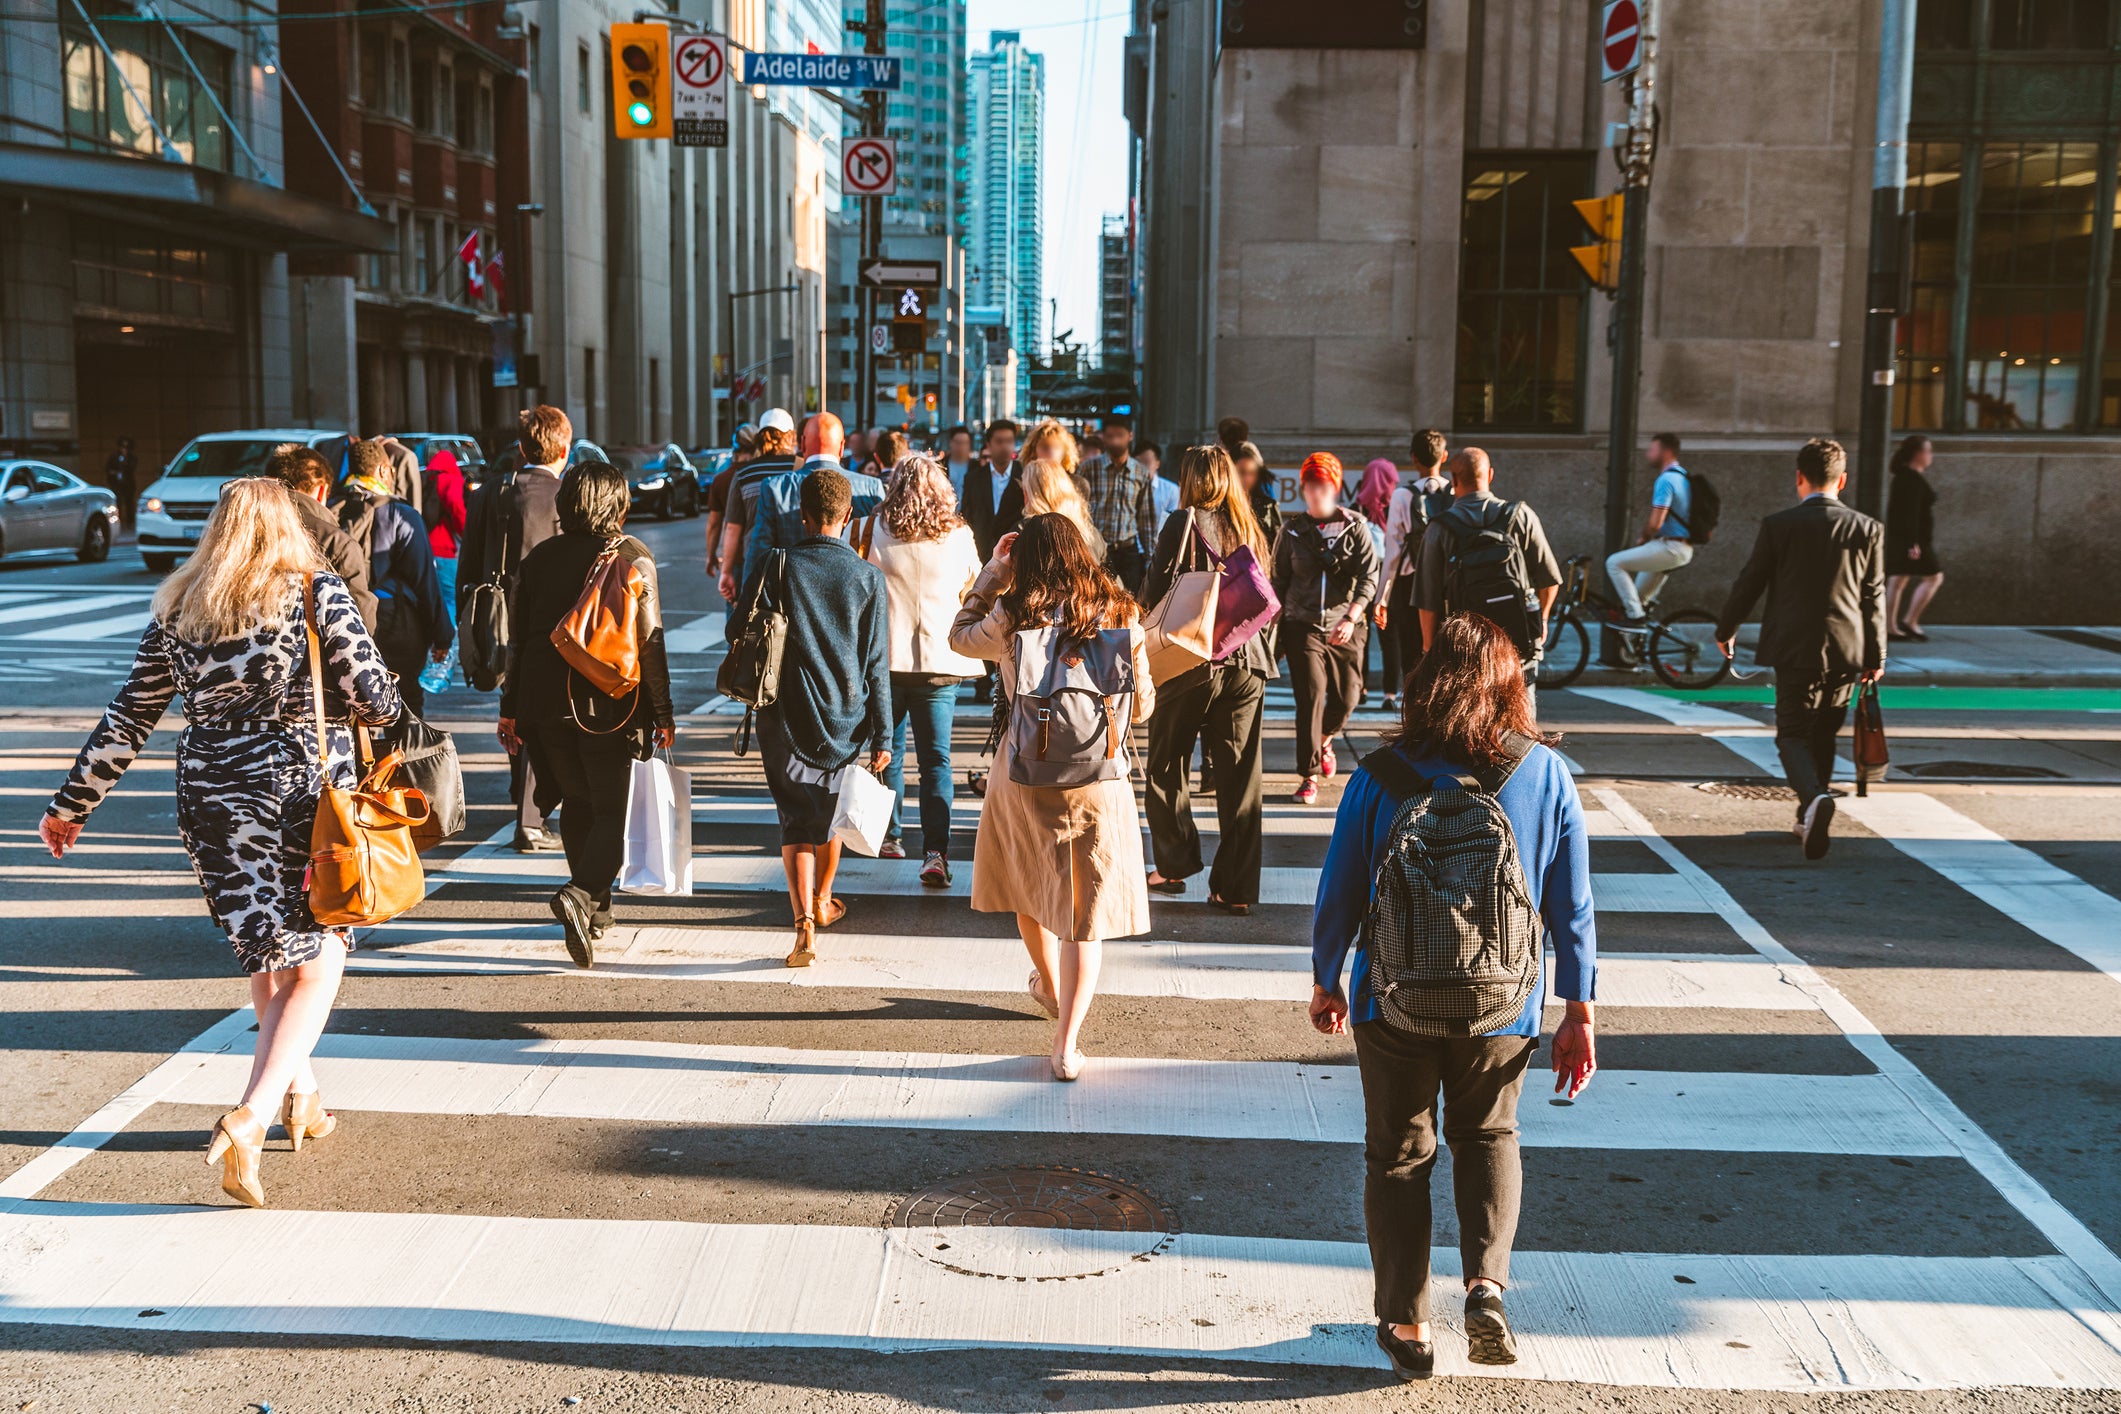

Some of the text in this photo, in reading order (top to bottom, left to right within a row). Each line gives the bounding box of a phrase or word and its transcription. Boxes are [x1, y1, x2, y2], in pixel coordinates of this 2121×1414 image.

[753, 55, 891, 82] Adelaide St W
[696, 123, 725, 133] BUSES
[679, 134, 724, 145] EXCEPTED
